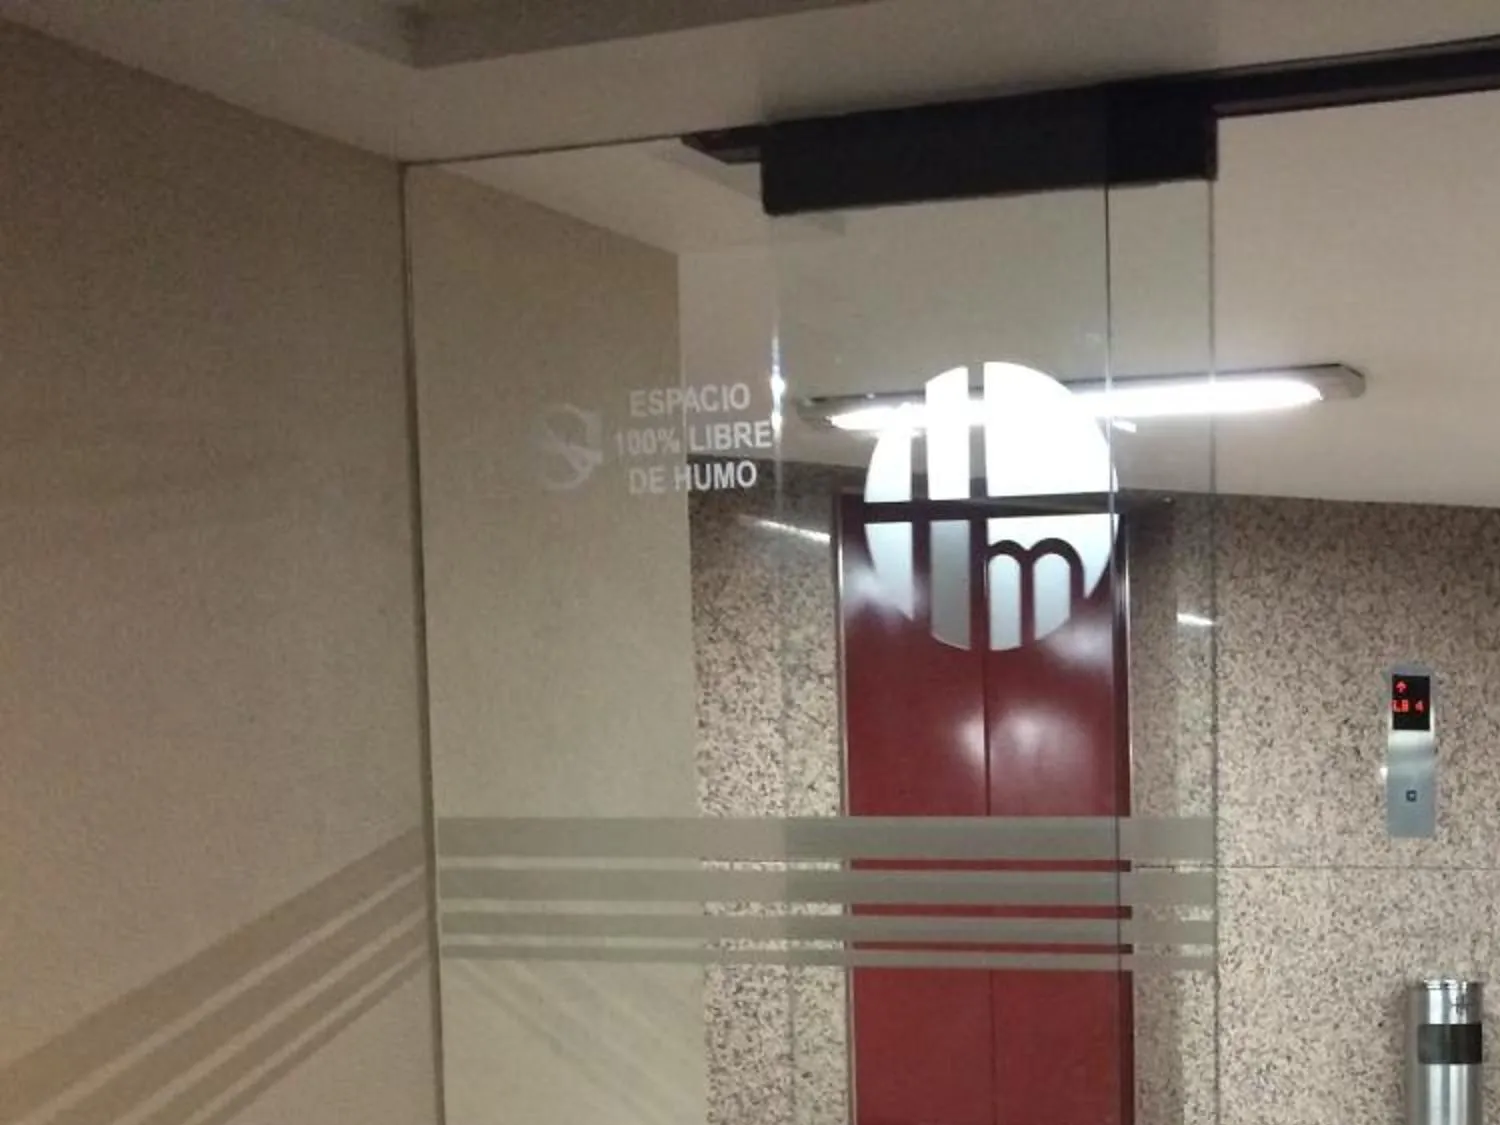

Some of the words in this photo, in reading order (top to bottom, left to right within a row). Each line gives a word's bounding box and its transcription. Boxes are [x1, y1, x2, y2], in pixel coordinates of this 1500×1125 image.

[629, 382, 750, 418] ESPACIO
[616, 426, 681, 456] 100%
[690, 420, 773, 452] LIBRE
[629, 465, 666, 494] DE
[674, 460, 758, 493] HUMO
